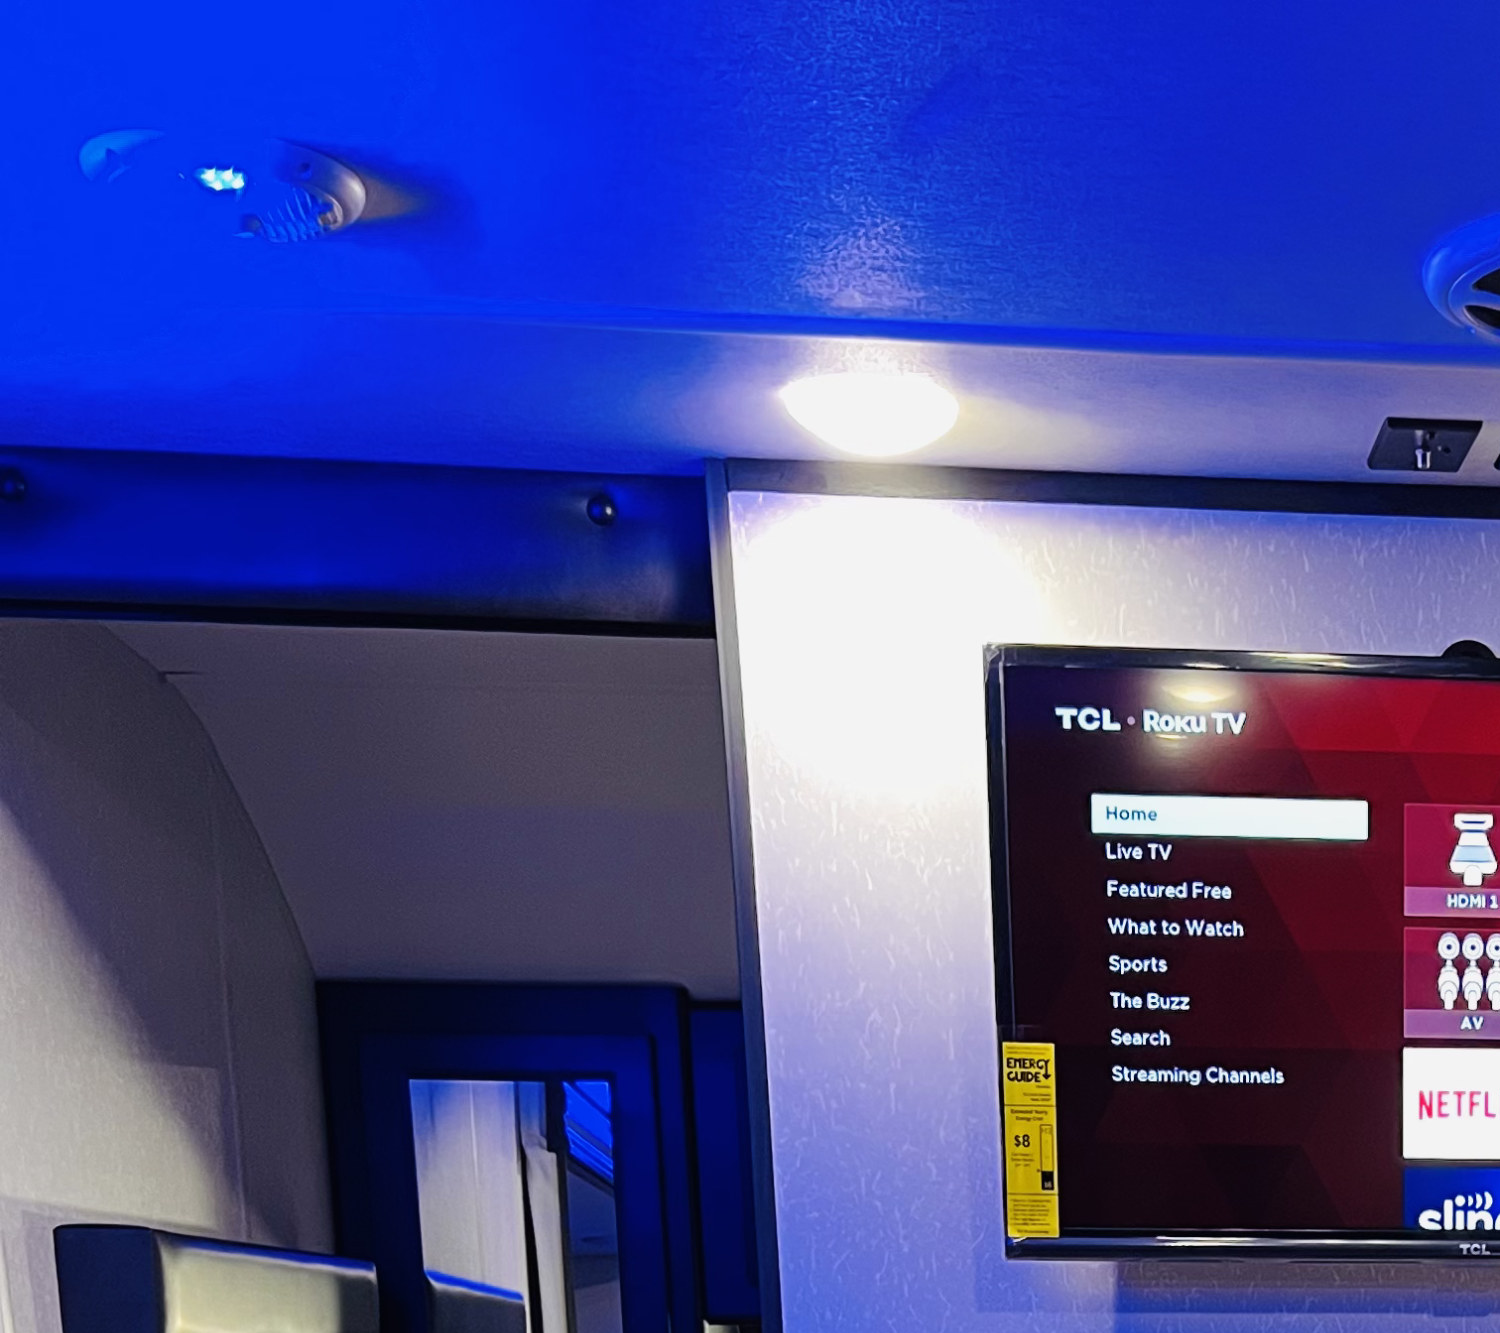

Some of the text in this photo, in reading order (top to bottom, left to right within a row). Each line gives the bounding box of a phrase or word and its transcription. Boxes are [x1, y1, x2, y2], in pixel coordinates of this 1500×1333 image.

[1055, 706, 1246, 735] TCL Roku TV
[1105, 805, 1158, 821] Home
[1105, 842, 1172, 860] Live TV
[1106, 880, 1232, 899] Featured Free
[1446, 894, 1499, 910] HDMI 1
[1107, 917, 1244, 937] What to Watch
[1108, 955, 1168, 975] Sports
[1109, 991, 1190, 1010] The Buzz
[1460, 1015, 1484, 1030] AV
[1110, 1028, 1171, 1046] Search
[1006, 1057, 1051, 1076] ENERGY
[1111, 1065, 1285, 1086] Streaming Channels
[1007, 1071, 1041, 1083] GUIDE
[1014, 1134, 1031, 1148] $8
[1459, 1243, 1491, 1256] TCL
